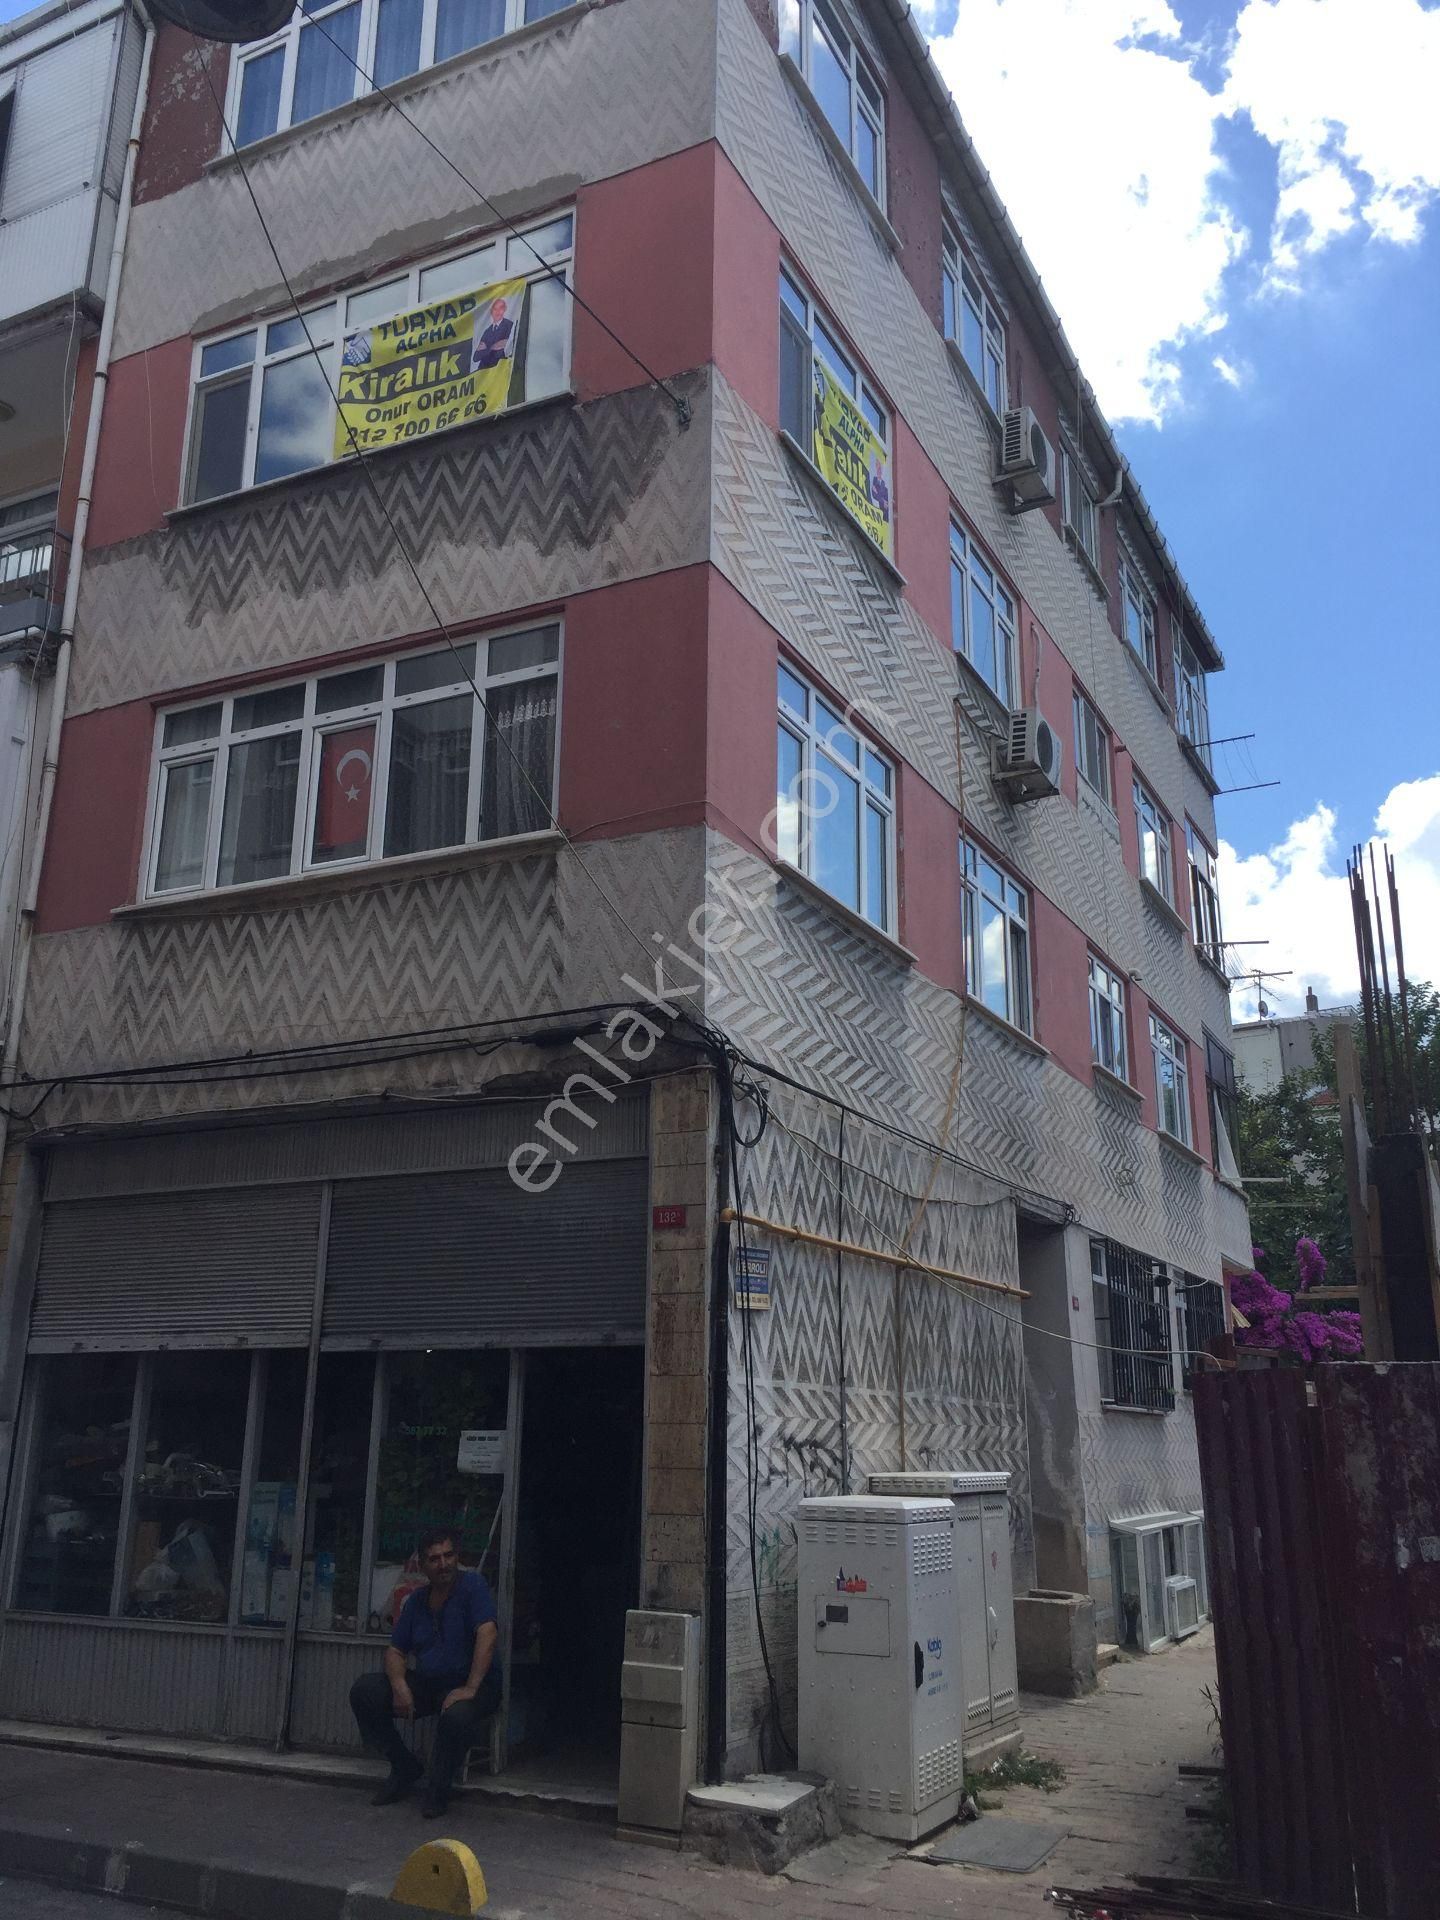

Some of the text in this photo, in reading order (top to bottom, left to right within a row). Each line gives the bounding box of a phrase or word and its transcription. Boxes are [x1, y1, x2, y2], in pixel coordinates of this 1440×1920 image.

[395, 323, 457, 353] ALPHA
[366, 377, 475, 423] Onur ORAM
[839, 415, 865, 457] ALPHA
